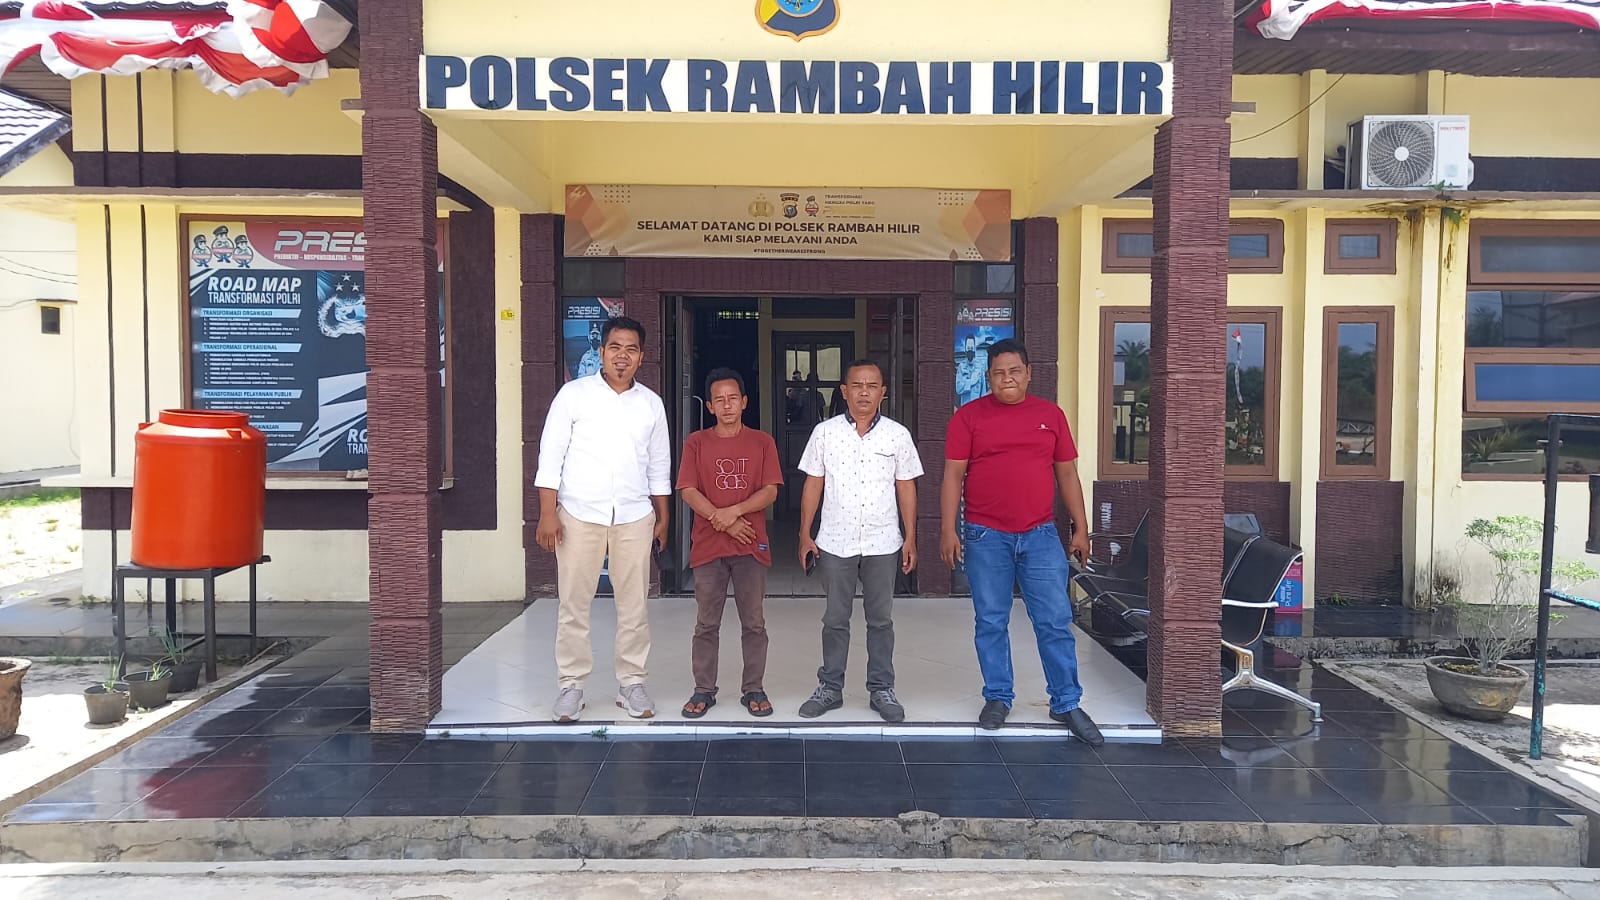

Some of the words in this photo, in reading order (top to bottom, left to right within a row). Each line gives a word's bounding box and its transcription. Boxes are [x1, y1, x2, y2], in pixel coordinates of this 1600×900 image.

[426, 55, 674, 113] POLSEK
[687, 59, 972, 115] RAMBAH
[991, 60, 1165, 116] HILIR
[637, 220, 698, 230] SELAMAT
[701, 221, 756, 231] DATANG
[758, 222, 772, 231] DI
[774, 222, 825, 232] POLSEK
[827, 223, 884, 233] RAMBAH
[887, 223, 920, 233] HILIR
[274, 230, 367, 252] PRES
[703, 234, 733, 243] KAMI
[735, 235, 762, 243] SIAP
[764, 235, 822, 244] MELAYANI
[824, 236, 858, 245] ANDA
[207, 276, 257, 291] ROAD
[262, 277, 302, 292] MAP
[208, 291, 274, 304] TRANSFORMASI
[276, 292, 301, 305] POLRI
[567, 306, 600, 315] PRESISI
[975, 308, 1012, 317] PRESISI
[347, 428, 368, 443] RO
[715, 458, 735, 475] SO
[737, 458, 749, 473] IT
[715, 474, 748, 490] GOES
